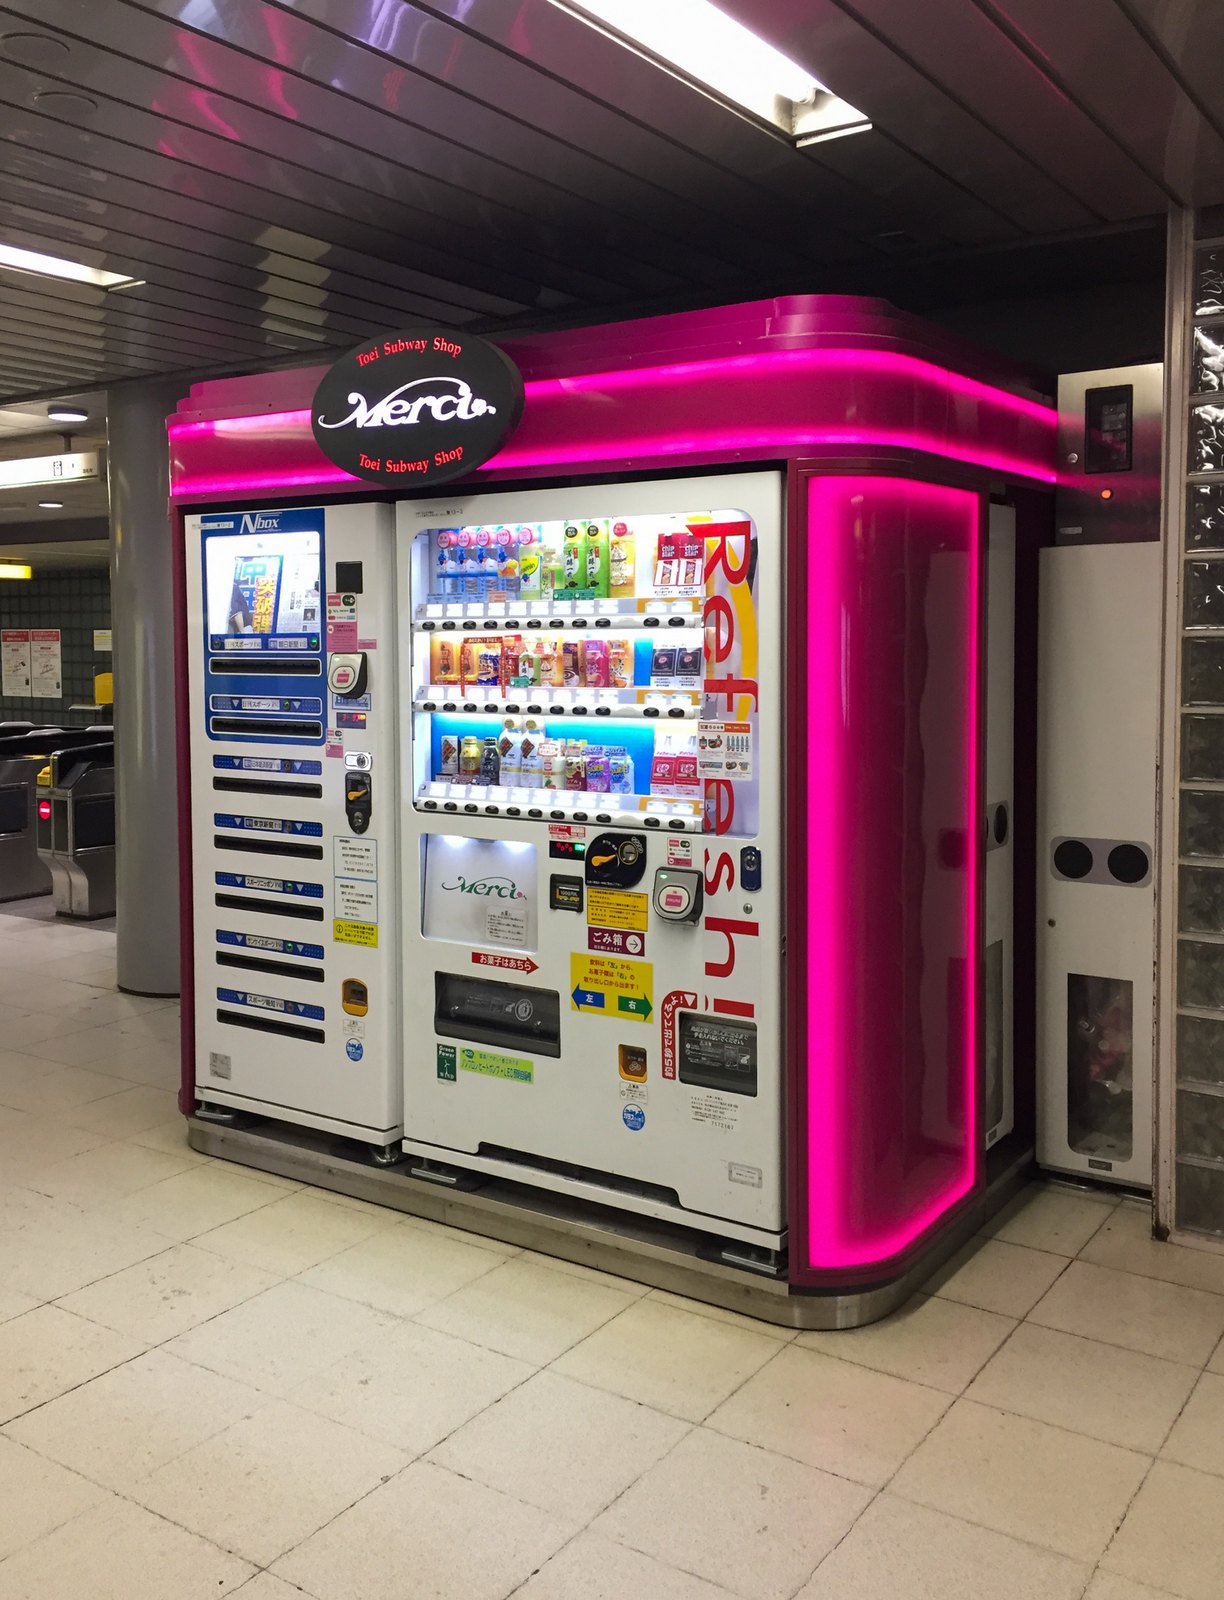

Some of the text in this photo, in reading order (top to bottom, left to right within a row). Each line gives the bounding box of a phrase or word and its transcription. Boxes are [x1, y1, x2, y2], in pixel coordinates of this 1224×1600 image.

[356, 337, 462, 367] Toei Subway Shop
[318, 376, 480, 429] Merci
[359, 445, 464, 474] Toei Subway Shop
[240, 512, 280, 534] Nbox
[253, 820, 274, 830] 東京新聞
[246, 877, 274, 889] スポーツニッポン
[441, 876, 520, 900] Merci
[247, 937, 275, 949] サンケイスポーツ
[593, 932, 623, 947] ごみ箱
[480, 954, 532, 971] お菓子はあちら
[586, 994, 594, 1003] 左
[628, 1001, 637, 1010] 右
[438, 1045, 455, 1053] Green
